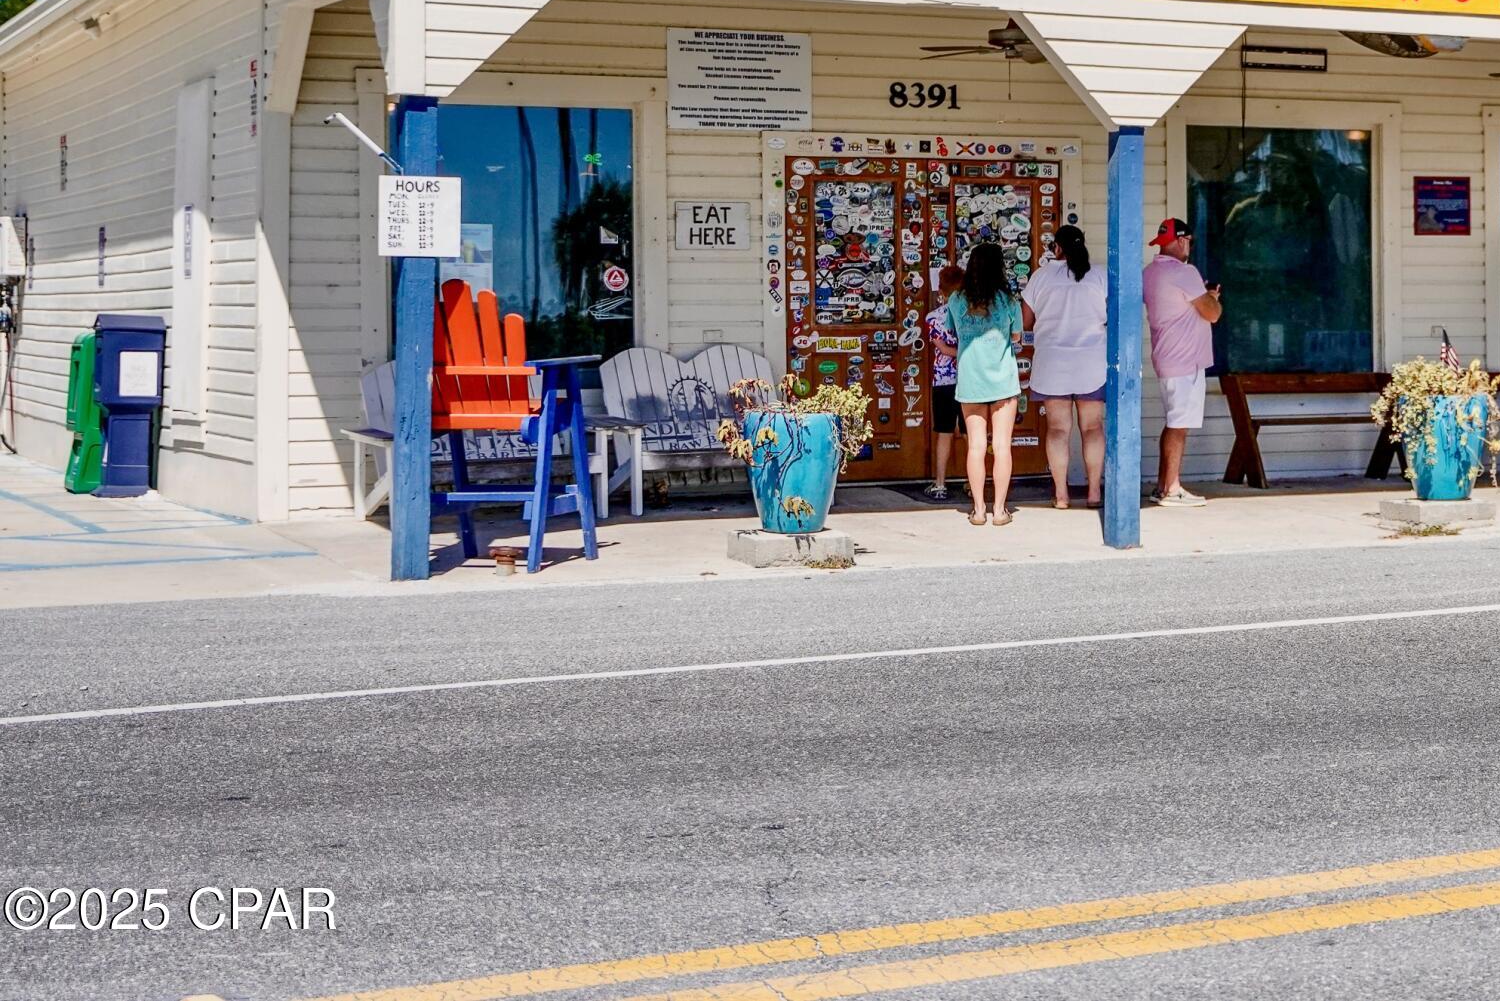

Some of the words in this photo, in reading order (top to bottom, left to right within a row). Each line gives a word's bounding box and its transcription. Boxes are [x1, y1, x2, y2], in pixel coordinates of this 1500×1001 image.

[694, 31, 703, 39] WE
[704, 32, 739, 40] APPRECIATE
[889, 82, 960, 110] 8391
[396, 180, 440, 192] HOURS
[692, 206, 730, 224] EAT
[689, 227, 736, 246] HERE
